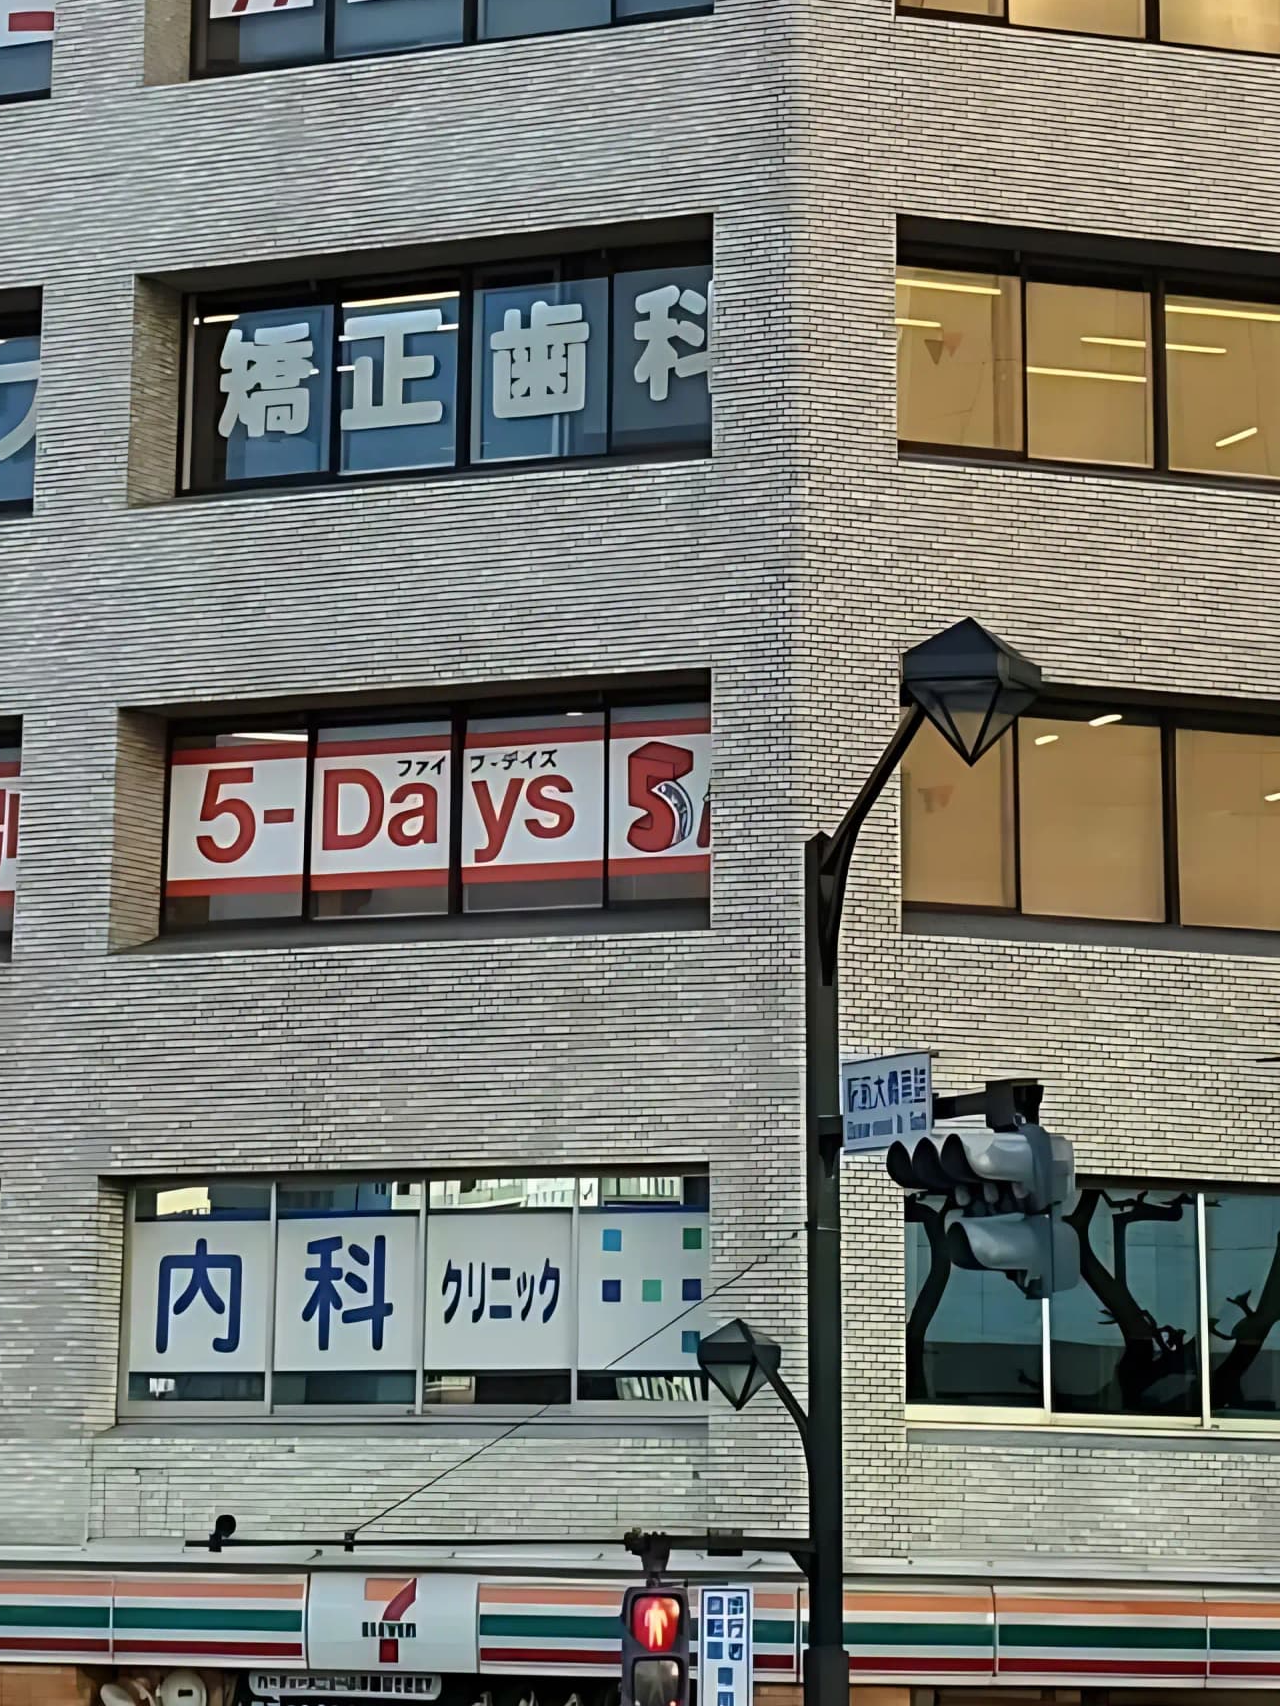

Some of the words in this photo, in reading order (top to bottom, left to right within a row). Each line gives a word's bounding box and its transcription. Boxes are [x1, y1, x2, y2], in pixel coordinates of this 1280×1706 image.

[218, 285, 713, 438] 矯正歯科
[155, 1235, 394, 1354] 内科
[442, 1257, 561, 1324] クリニック
